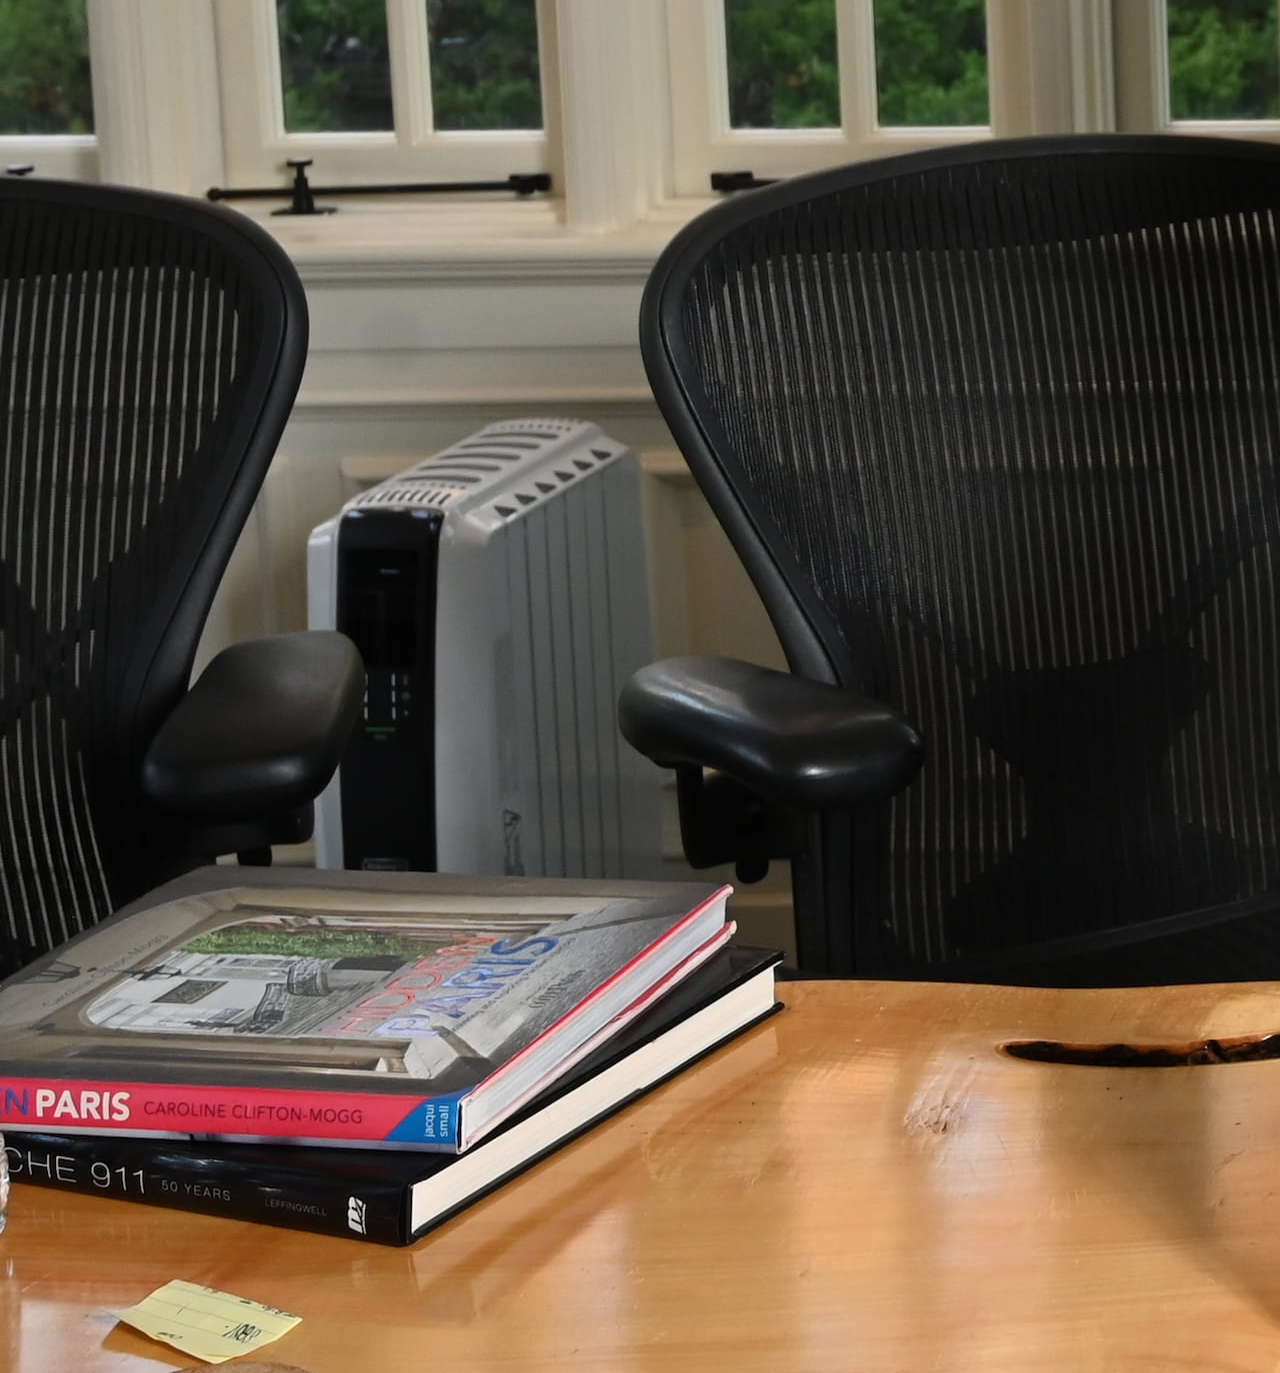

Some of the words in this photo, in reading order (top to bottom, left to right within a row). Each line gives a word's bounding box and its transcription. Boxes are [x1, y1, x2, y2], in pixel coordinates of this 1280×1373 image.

[367, 936, 559, 1037] PARIS
[0, 1087, 29, 1115] N
[36, 1089, 130, 1121] PARIS
[144, 1101, 226, 1118] CAROLINE
[232, 1104, 363, 1124] CLIFTON-MOGG
[424, 1104, 435, 1137] jacqui
[440, 1105, 449, 1137] small
[91, 1162, 145, 1194] 911
[161, 1179, 178, 1192] 50
[184, 1185, 231, 1201] YEARS
[264, 1197, 327, 1216] LEFFINGWELL
